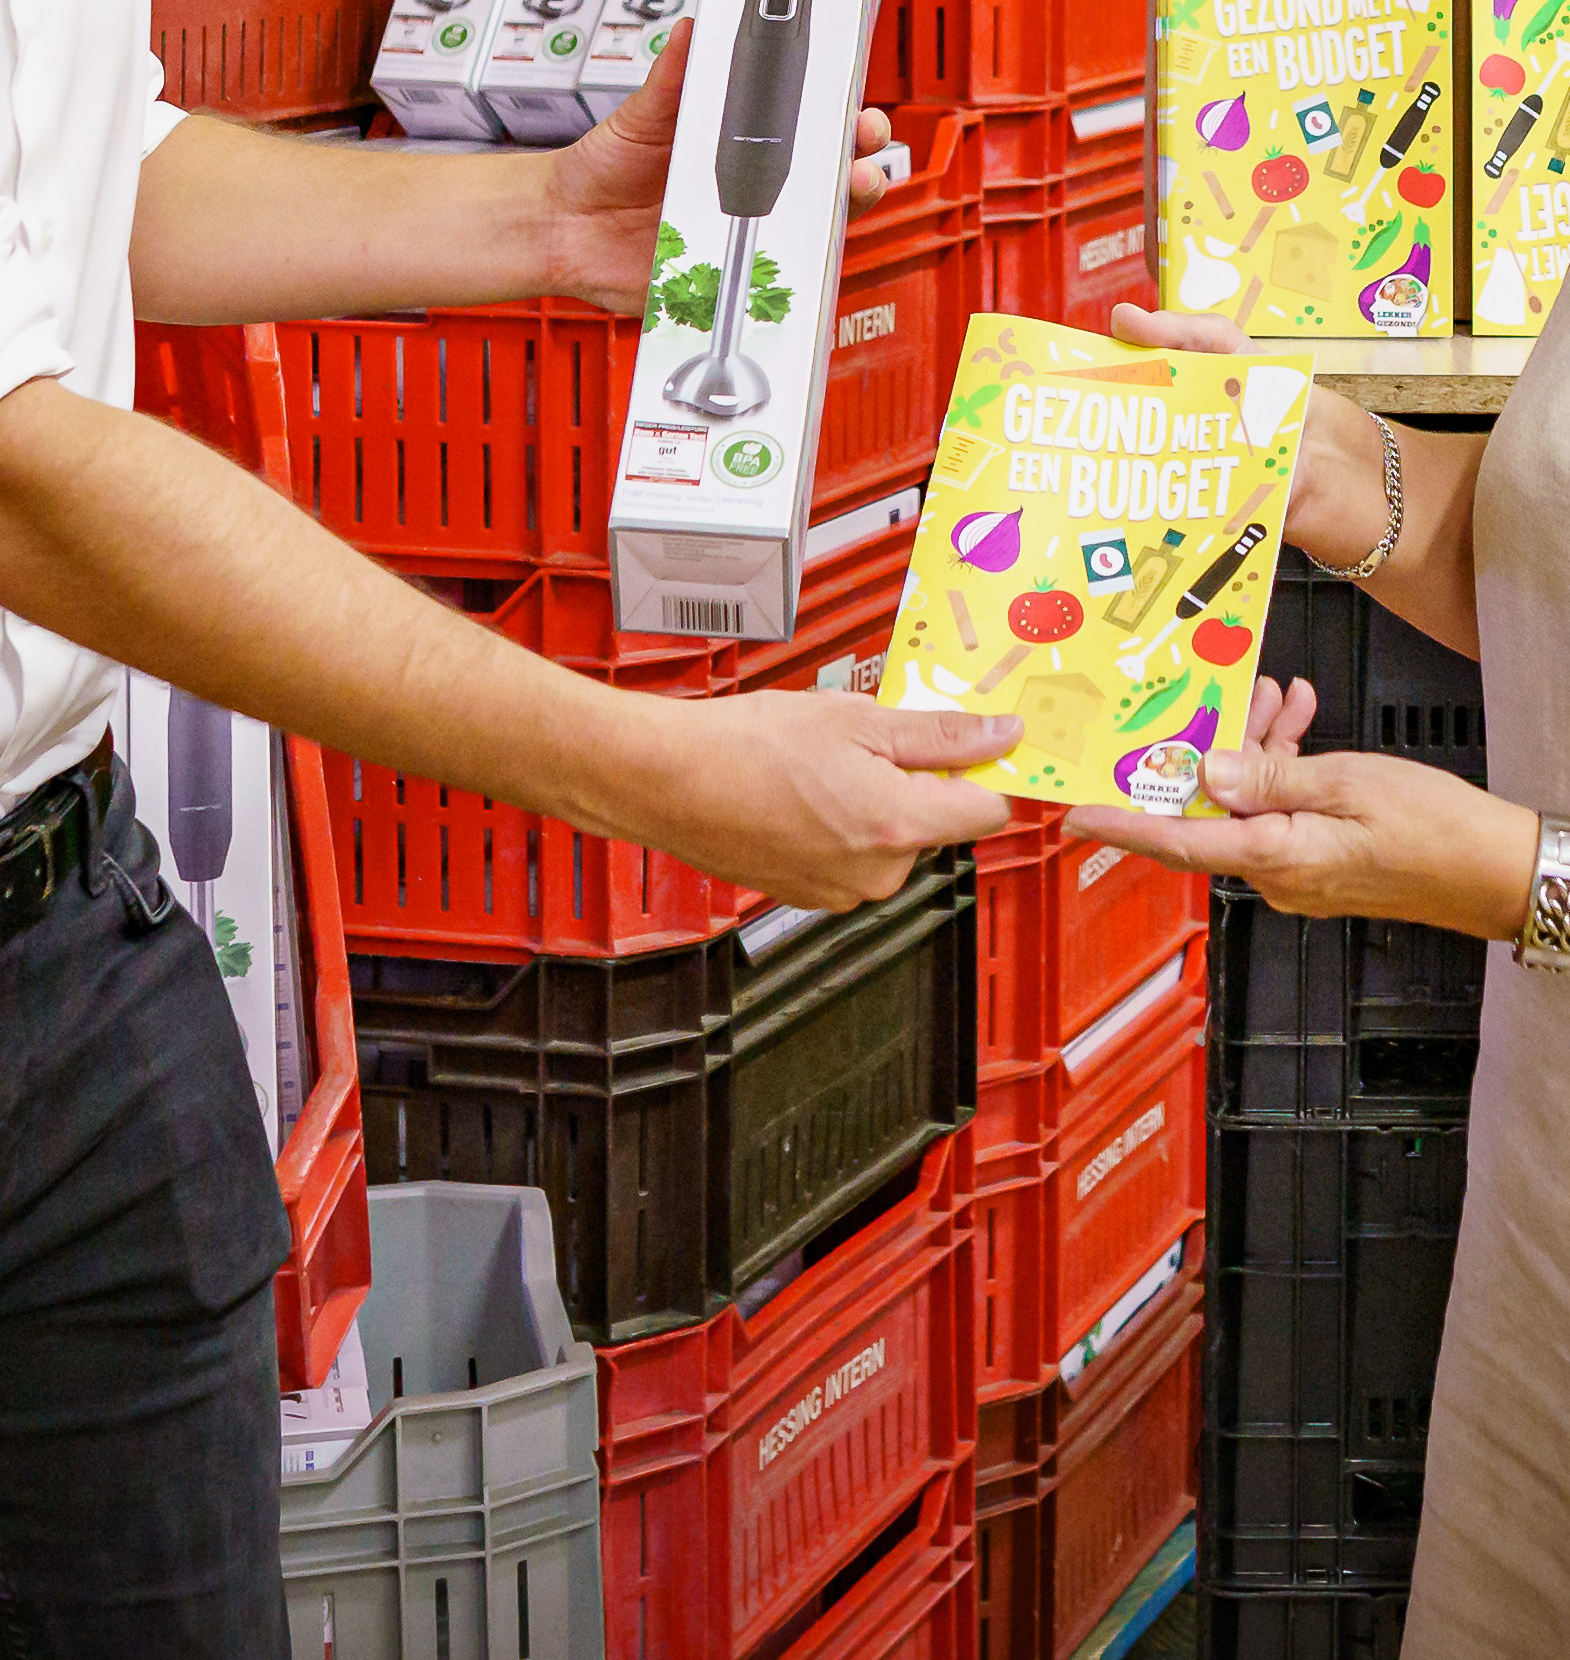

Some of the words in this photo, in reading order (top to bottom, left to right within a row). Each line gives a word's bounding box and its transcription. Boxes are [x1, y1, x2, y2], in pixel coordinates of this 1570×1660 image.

[1227, 41, 1271, 80] EEN
[1275, 20, 1407, 91] BUDGET
[838, 302, 896, 349] INTERN
[658, 445, 677, 456] gut
[1002, 383, 1167, 456] GEZOND
[1172, 411, 1232, 453] MET
[732, 452, 760, 466] BPA
[1008, 452, 1061, 494] EEN
[1067, 455, 1240, 521] BUDGET
[759, 1386, 822, 1471] HESSING
[824, 1337, 886, 1409] INTERN
